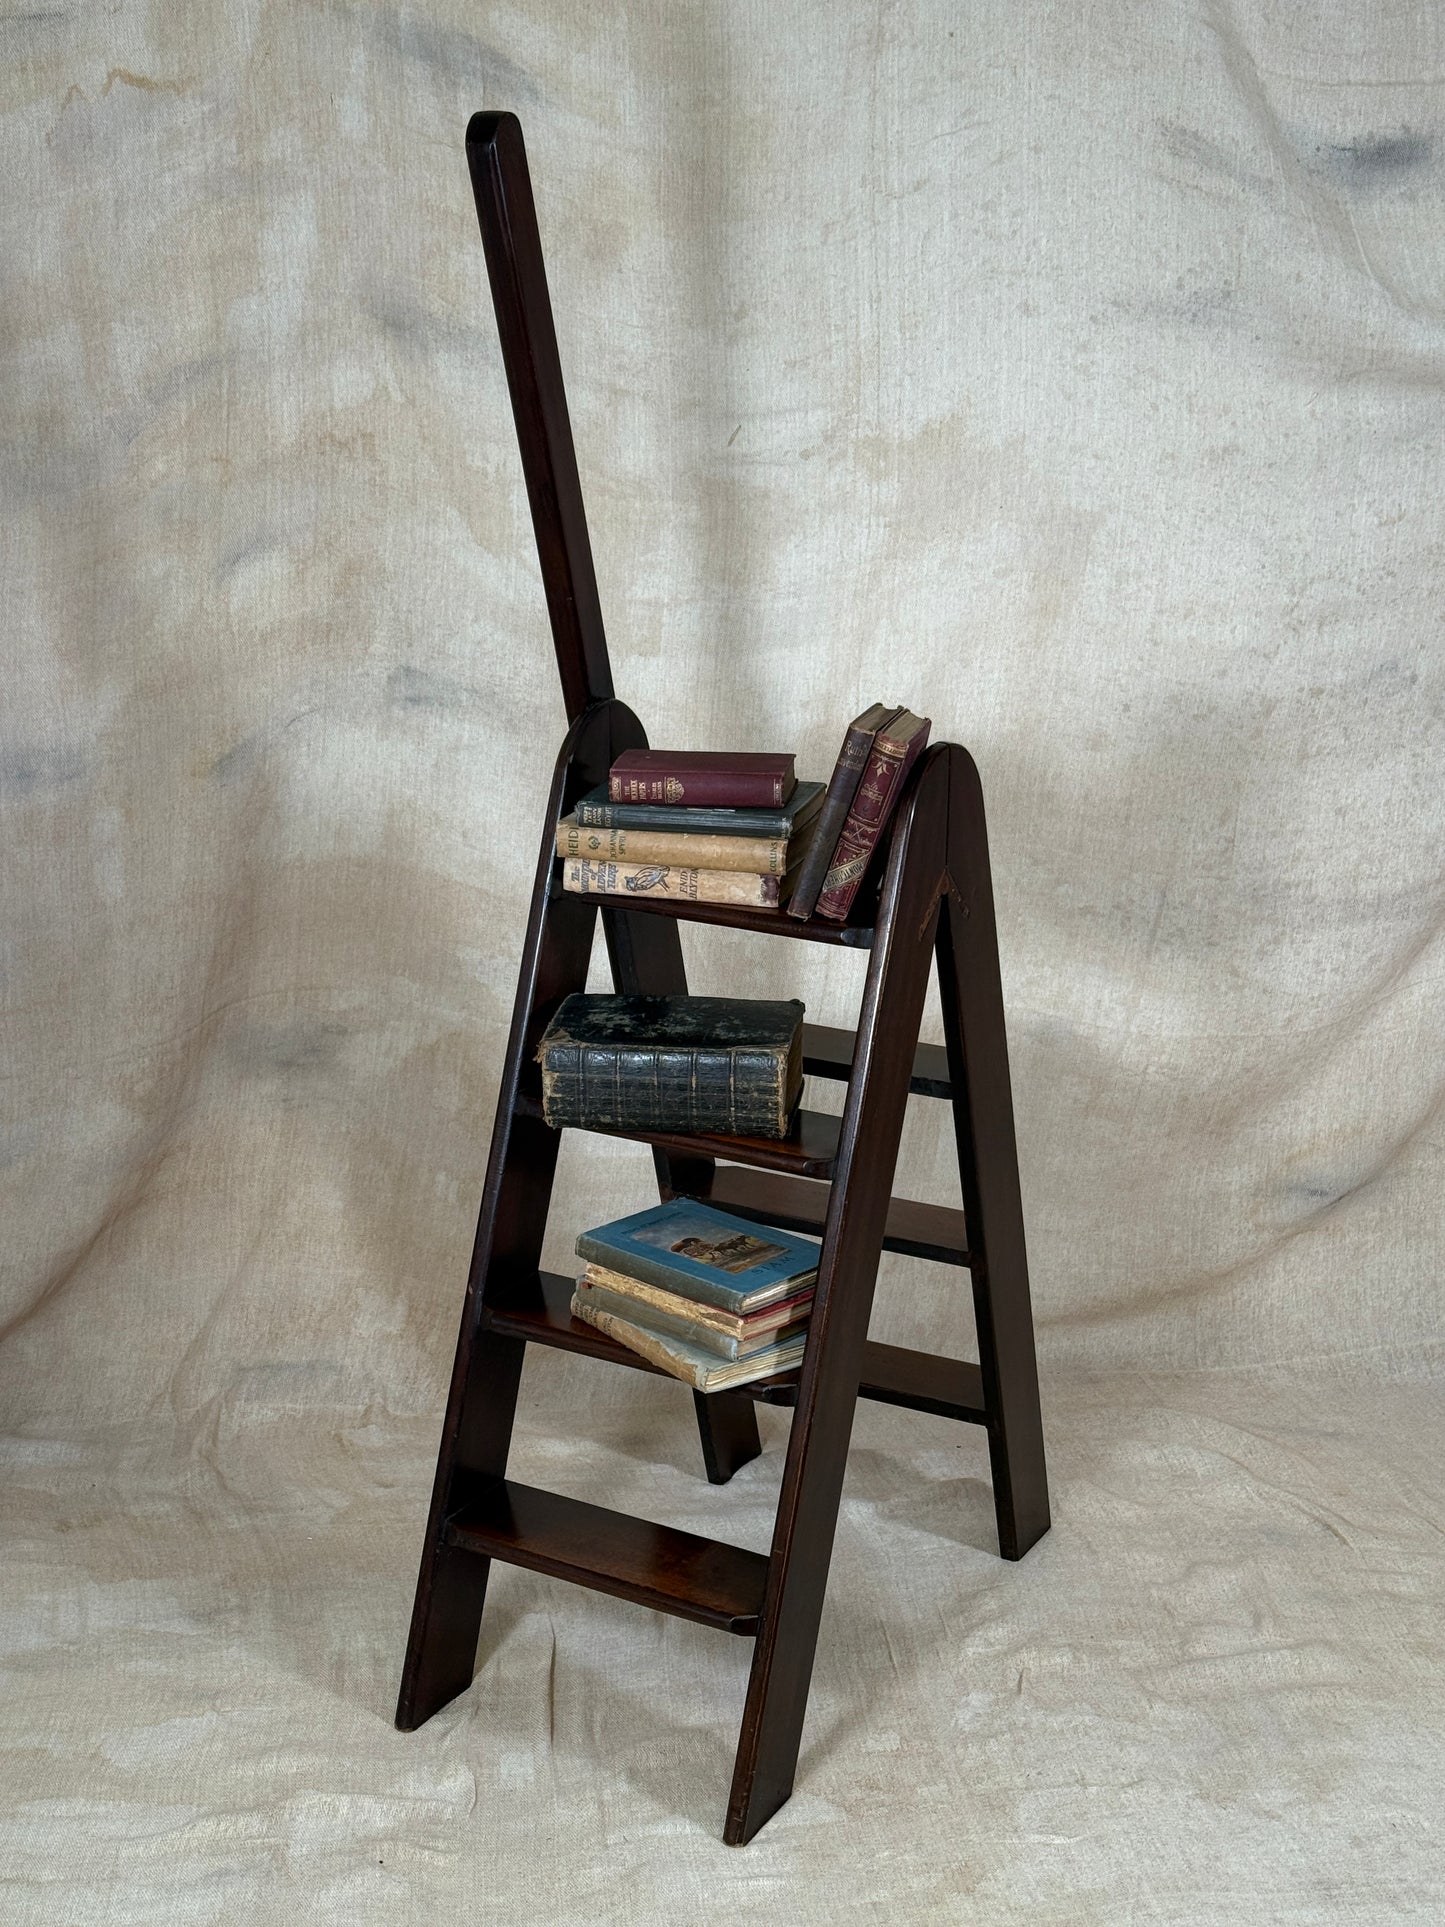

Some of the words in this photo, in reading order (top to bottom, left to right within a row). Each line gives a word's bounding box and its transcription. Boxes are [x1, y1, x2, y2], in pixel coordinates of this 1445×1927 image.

[568, 827, 579, 856] HEIDI
[609, 829, 617, 859] JOHANNA
[618, 836, 626, 855] SPYRI
[769, 841, 777, 872] COLLINS
[571, 866, 580, 882] The
[679, 871, 688, 894] ENID
[750, 1256, 793, 1275] SIAM
